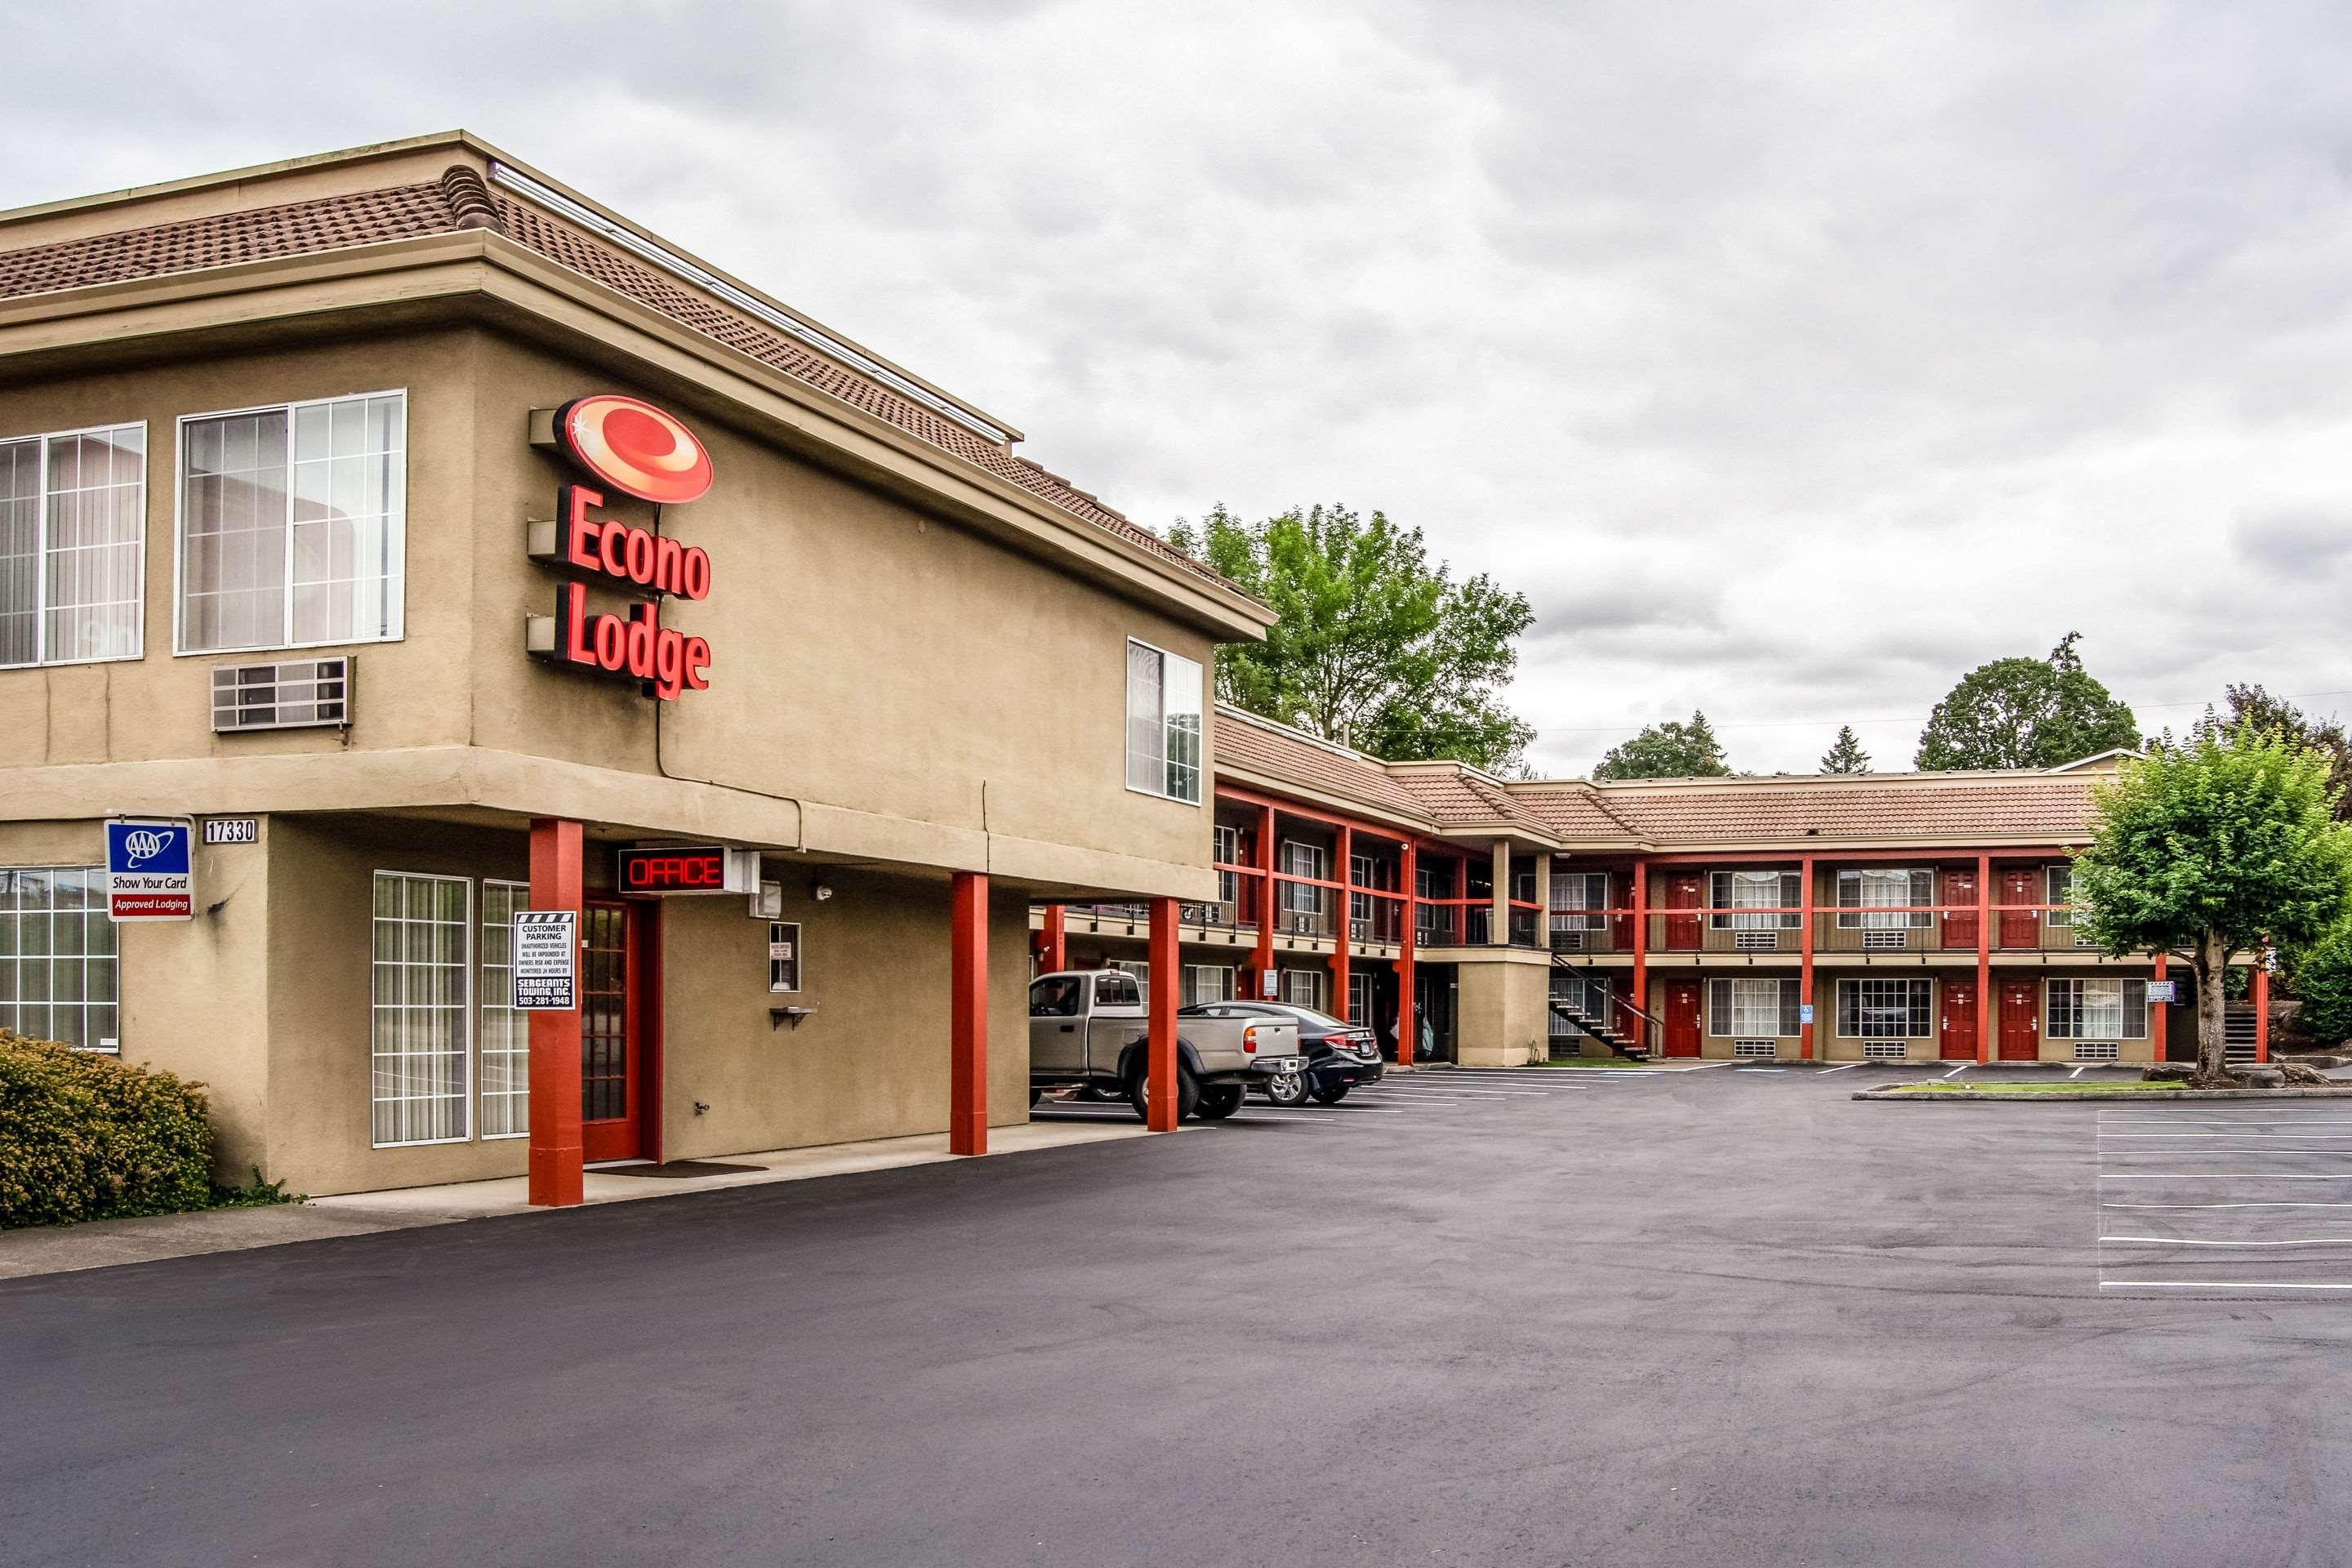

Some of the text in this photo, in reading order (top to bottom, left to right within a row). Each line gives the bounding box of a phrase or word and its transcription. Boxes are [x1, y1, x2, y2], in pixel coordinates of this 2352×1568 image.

[568, 485, 710, 600] Econo
[568, 582, 710, 701] Lodge
[209, 821, 253, 841] 17330
[129, 831, 158, 857] AAA
[630, 858, 720, 884] OFFICE
[113, 876, 187, 889] Show Your Card
[115, 899, 188, 911] Approved Lodging
[523, 924, 566, 933] CUSTOMER
[518, 979, 570, 987] SERGEANTS
[519, 996, 570, 1005] 503-281-1948
